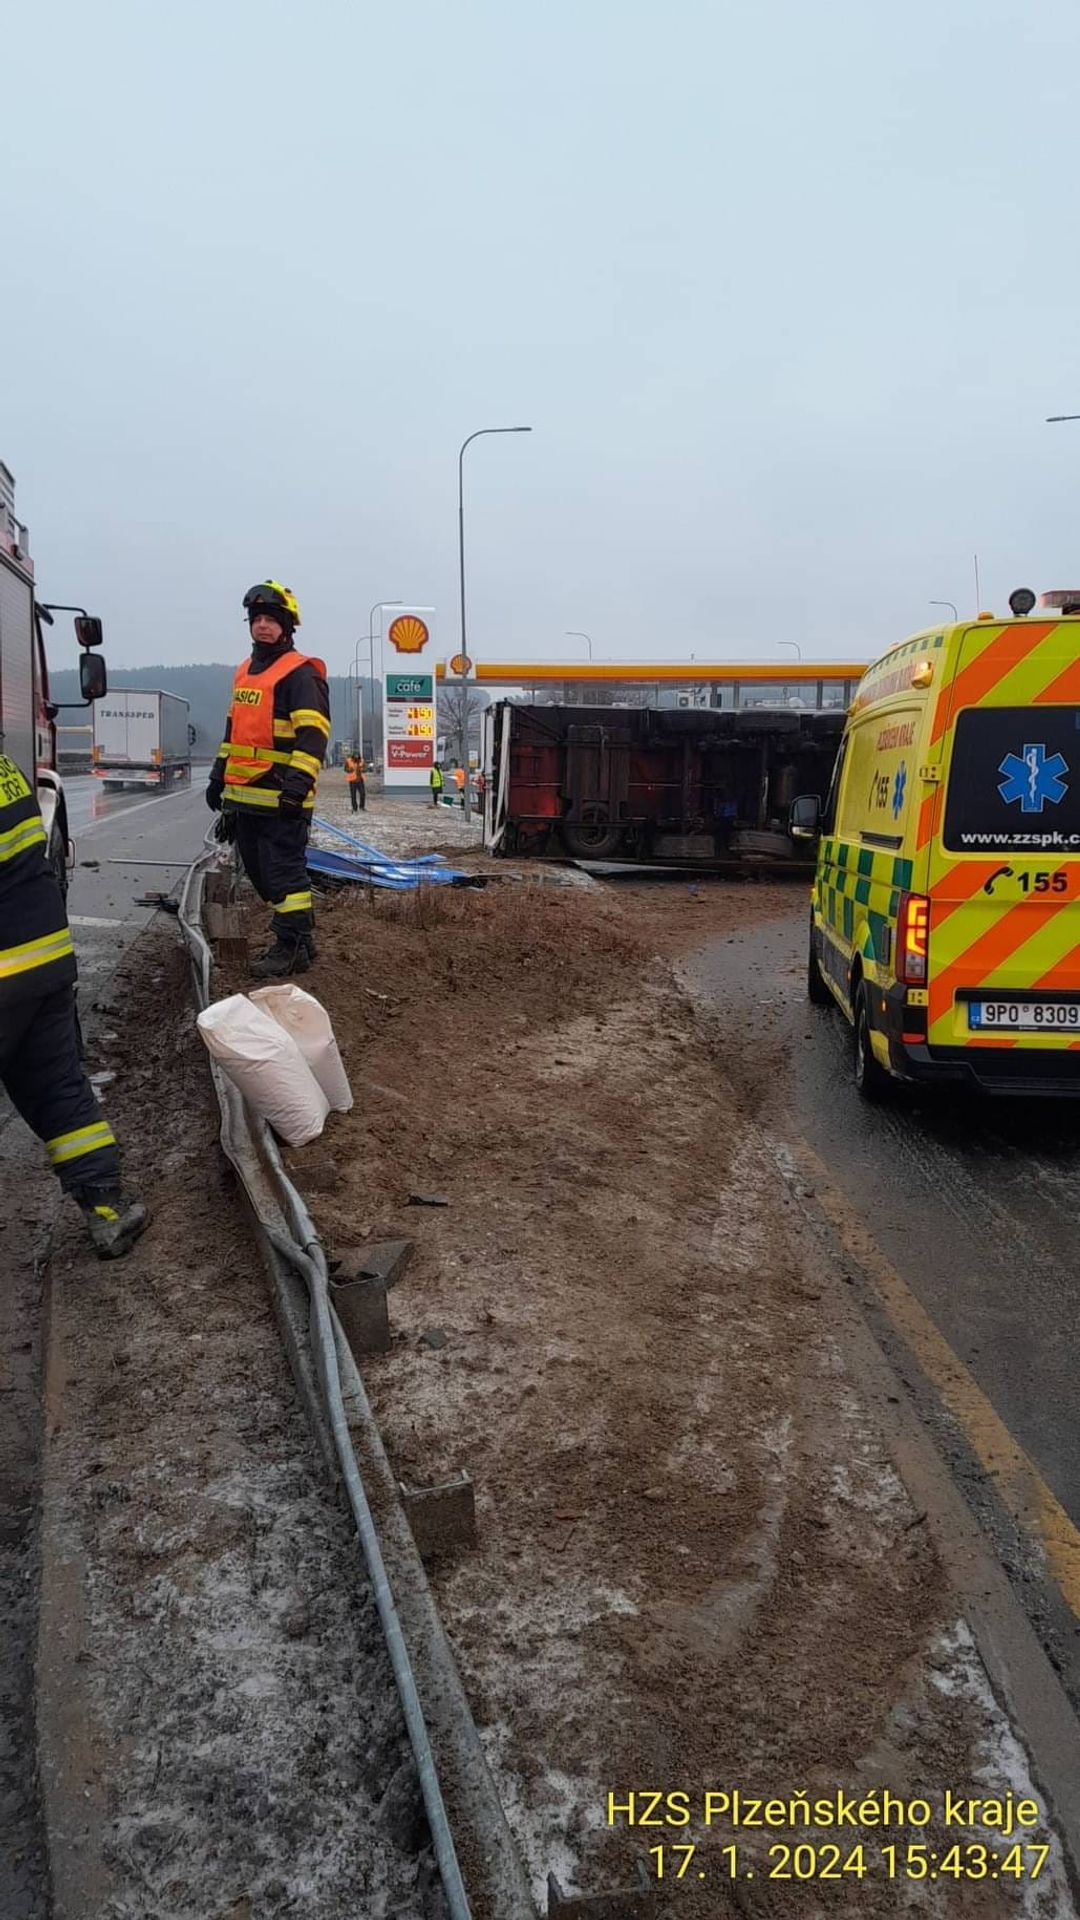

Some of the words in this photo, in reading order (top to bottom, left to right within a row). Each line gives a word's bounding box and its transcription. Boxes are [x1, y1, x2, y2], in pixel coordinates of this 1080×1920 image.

[876, 776, 890, 809] 155
[961, 831, 1080, 848] www.zzspk.c
[1017, 872, 1068, 893] 155
[1033, 1006, 1078, 1025] 8309
